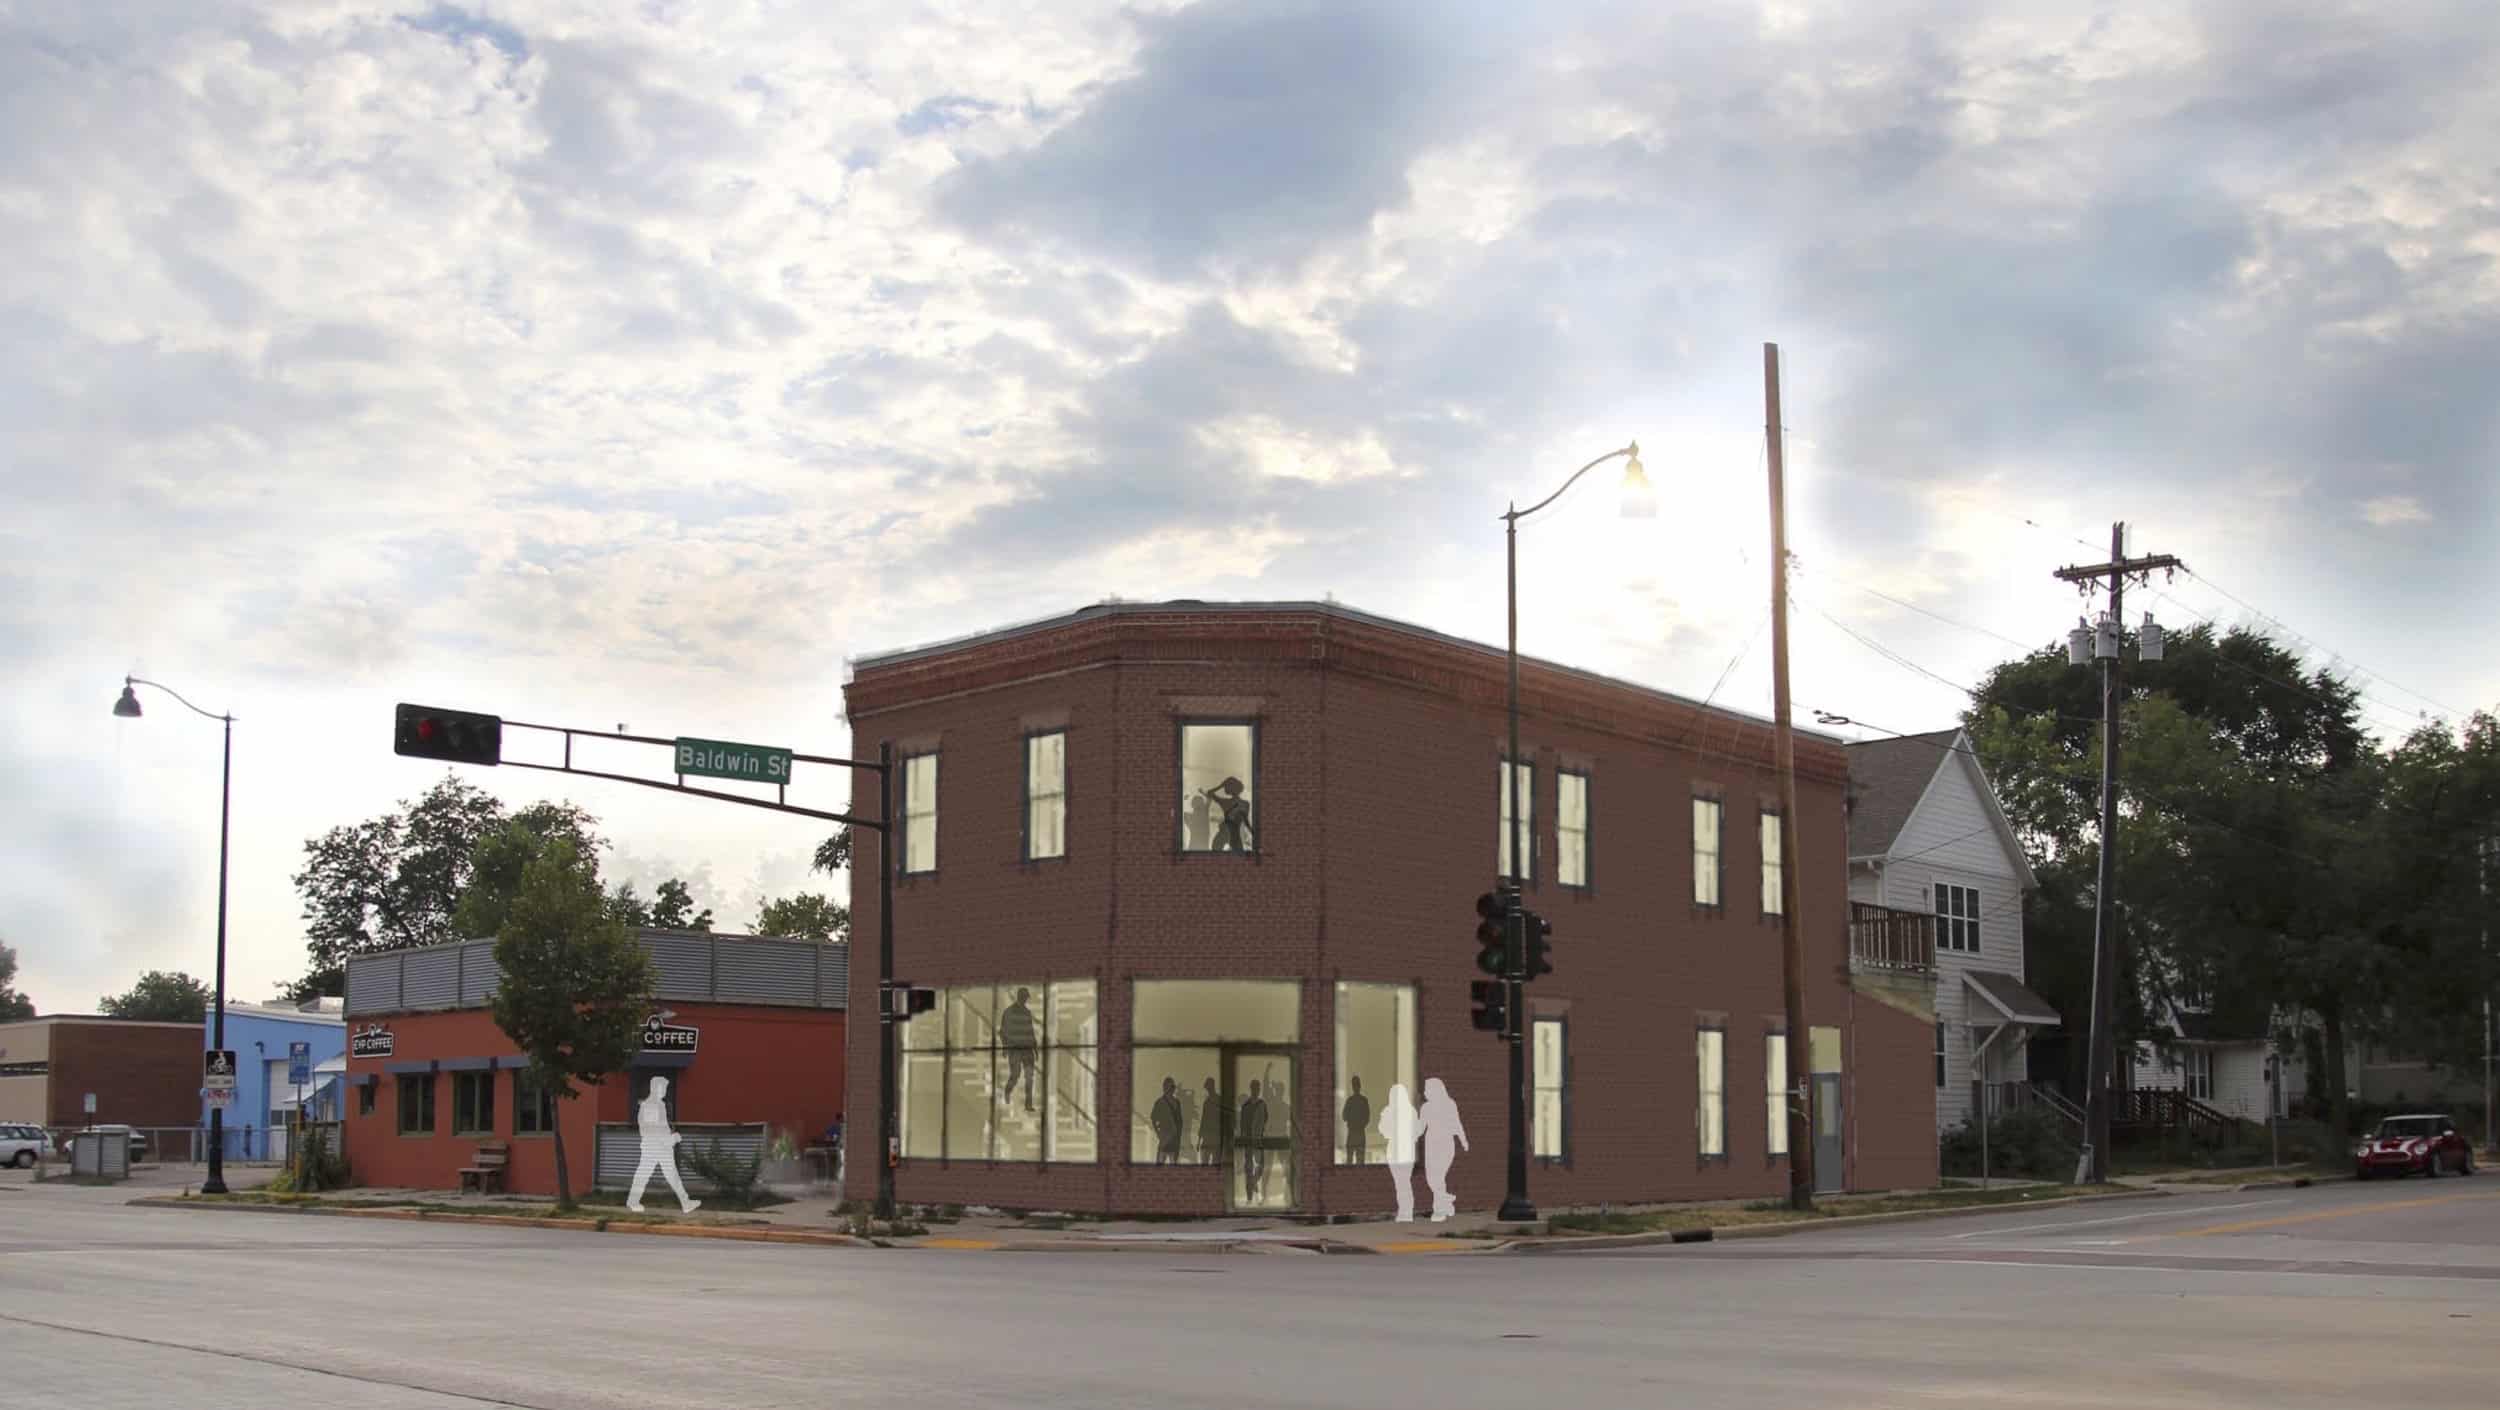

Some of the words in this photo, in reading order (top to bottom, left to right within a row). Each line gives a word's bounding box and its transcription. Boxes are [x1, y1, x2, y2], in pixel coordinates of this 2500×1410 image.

[679, 745, 759, 774] Baldwin
[767, 754, 788, 776] St
[367, 1038, 392, 1049] COFFEE
[644, 1031, 695, 1044] COFFEE
